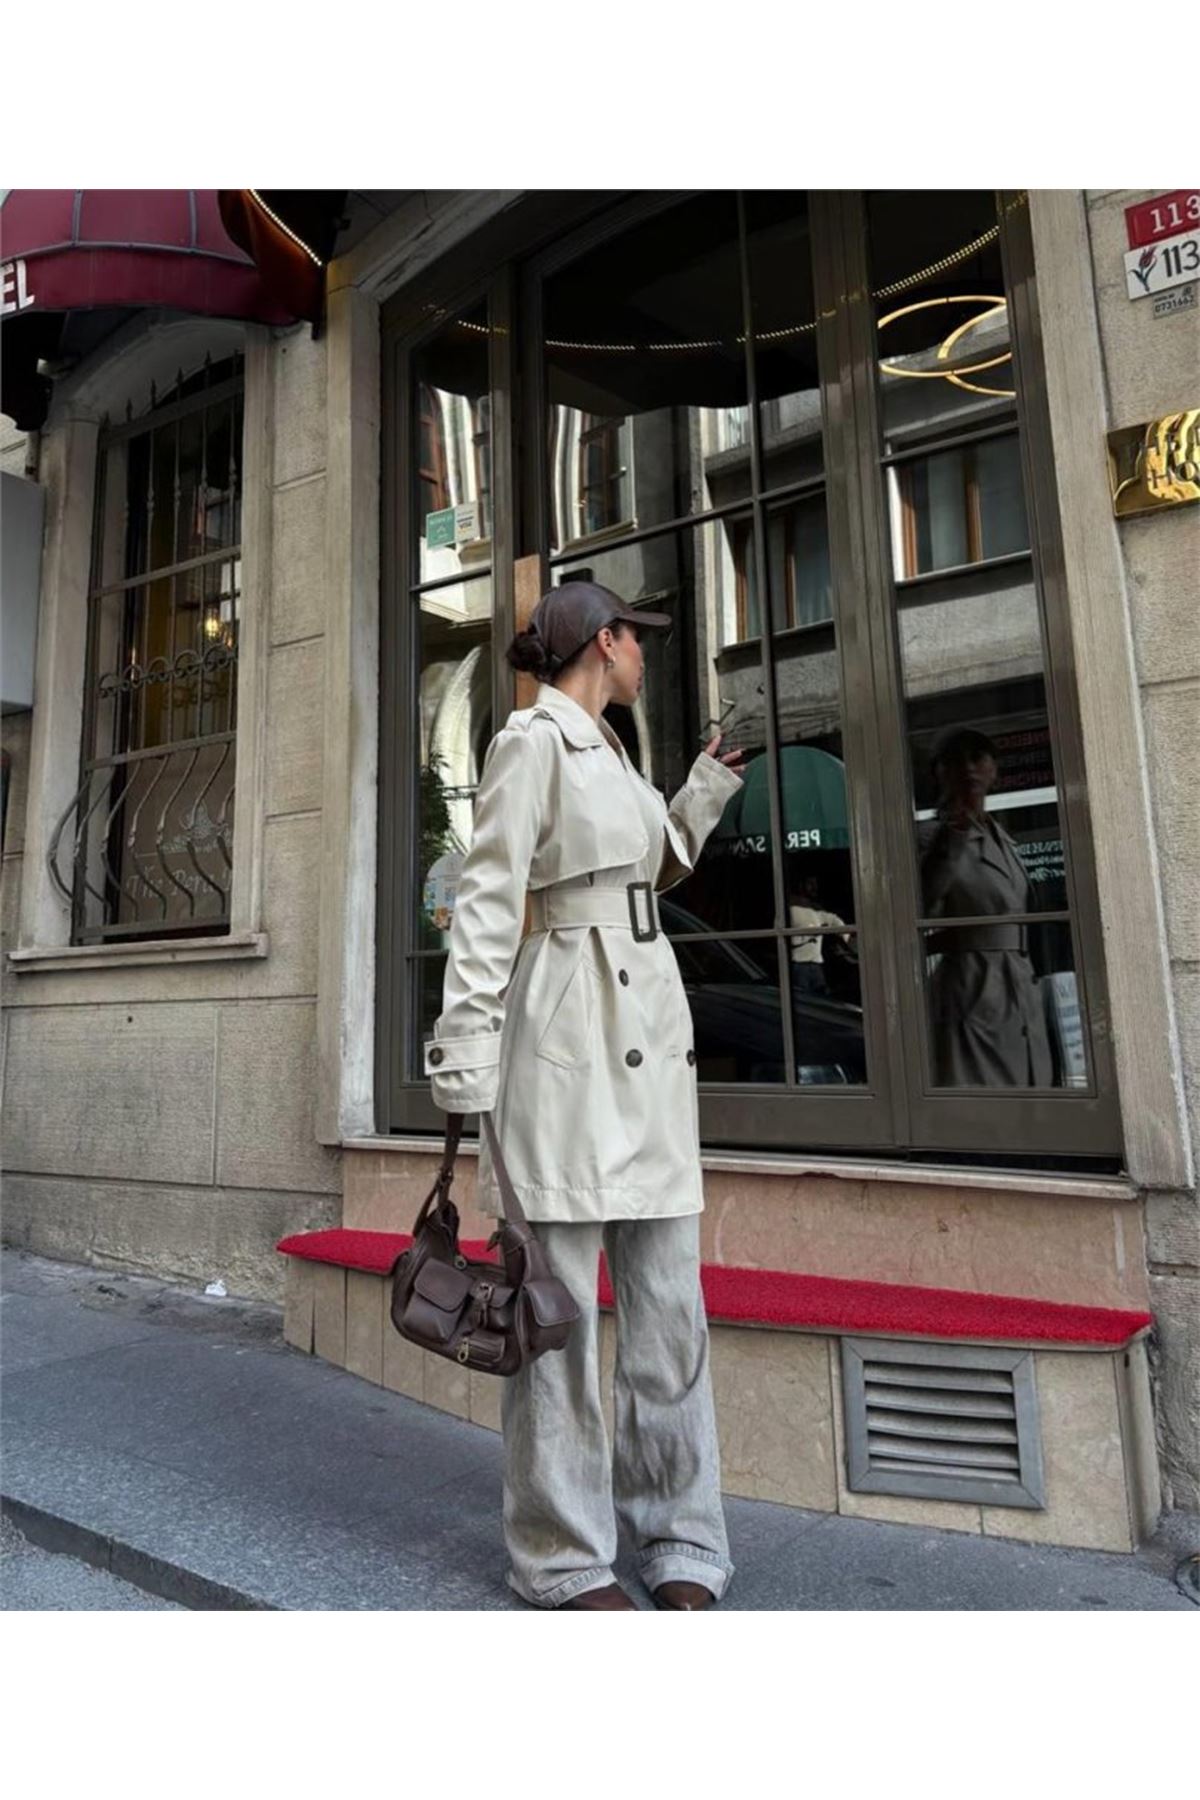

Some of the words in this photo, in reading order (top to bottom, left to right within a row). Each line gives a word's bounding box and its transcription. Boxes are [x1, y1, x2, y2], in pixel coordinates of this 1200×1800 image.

[1150, 195, 1200, 233] 113
[1161, 240, 1200, 278] 113
[0, 259, 35, 316] EL
